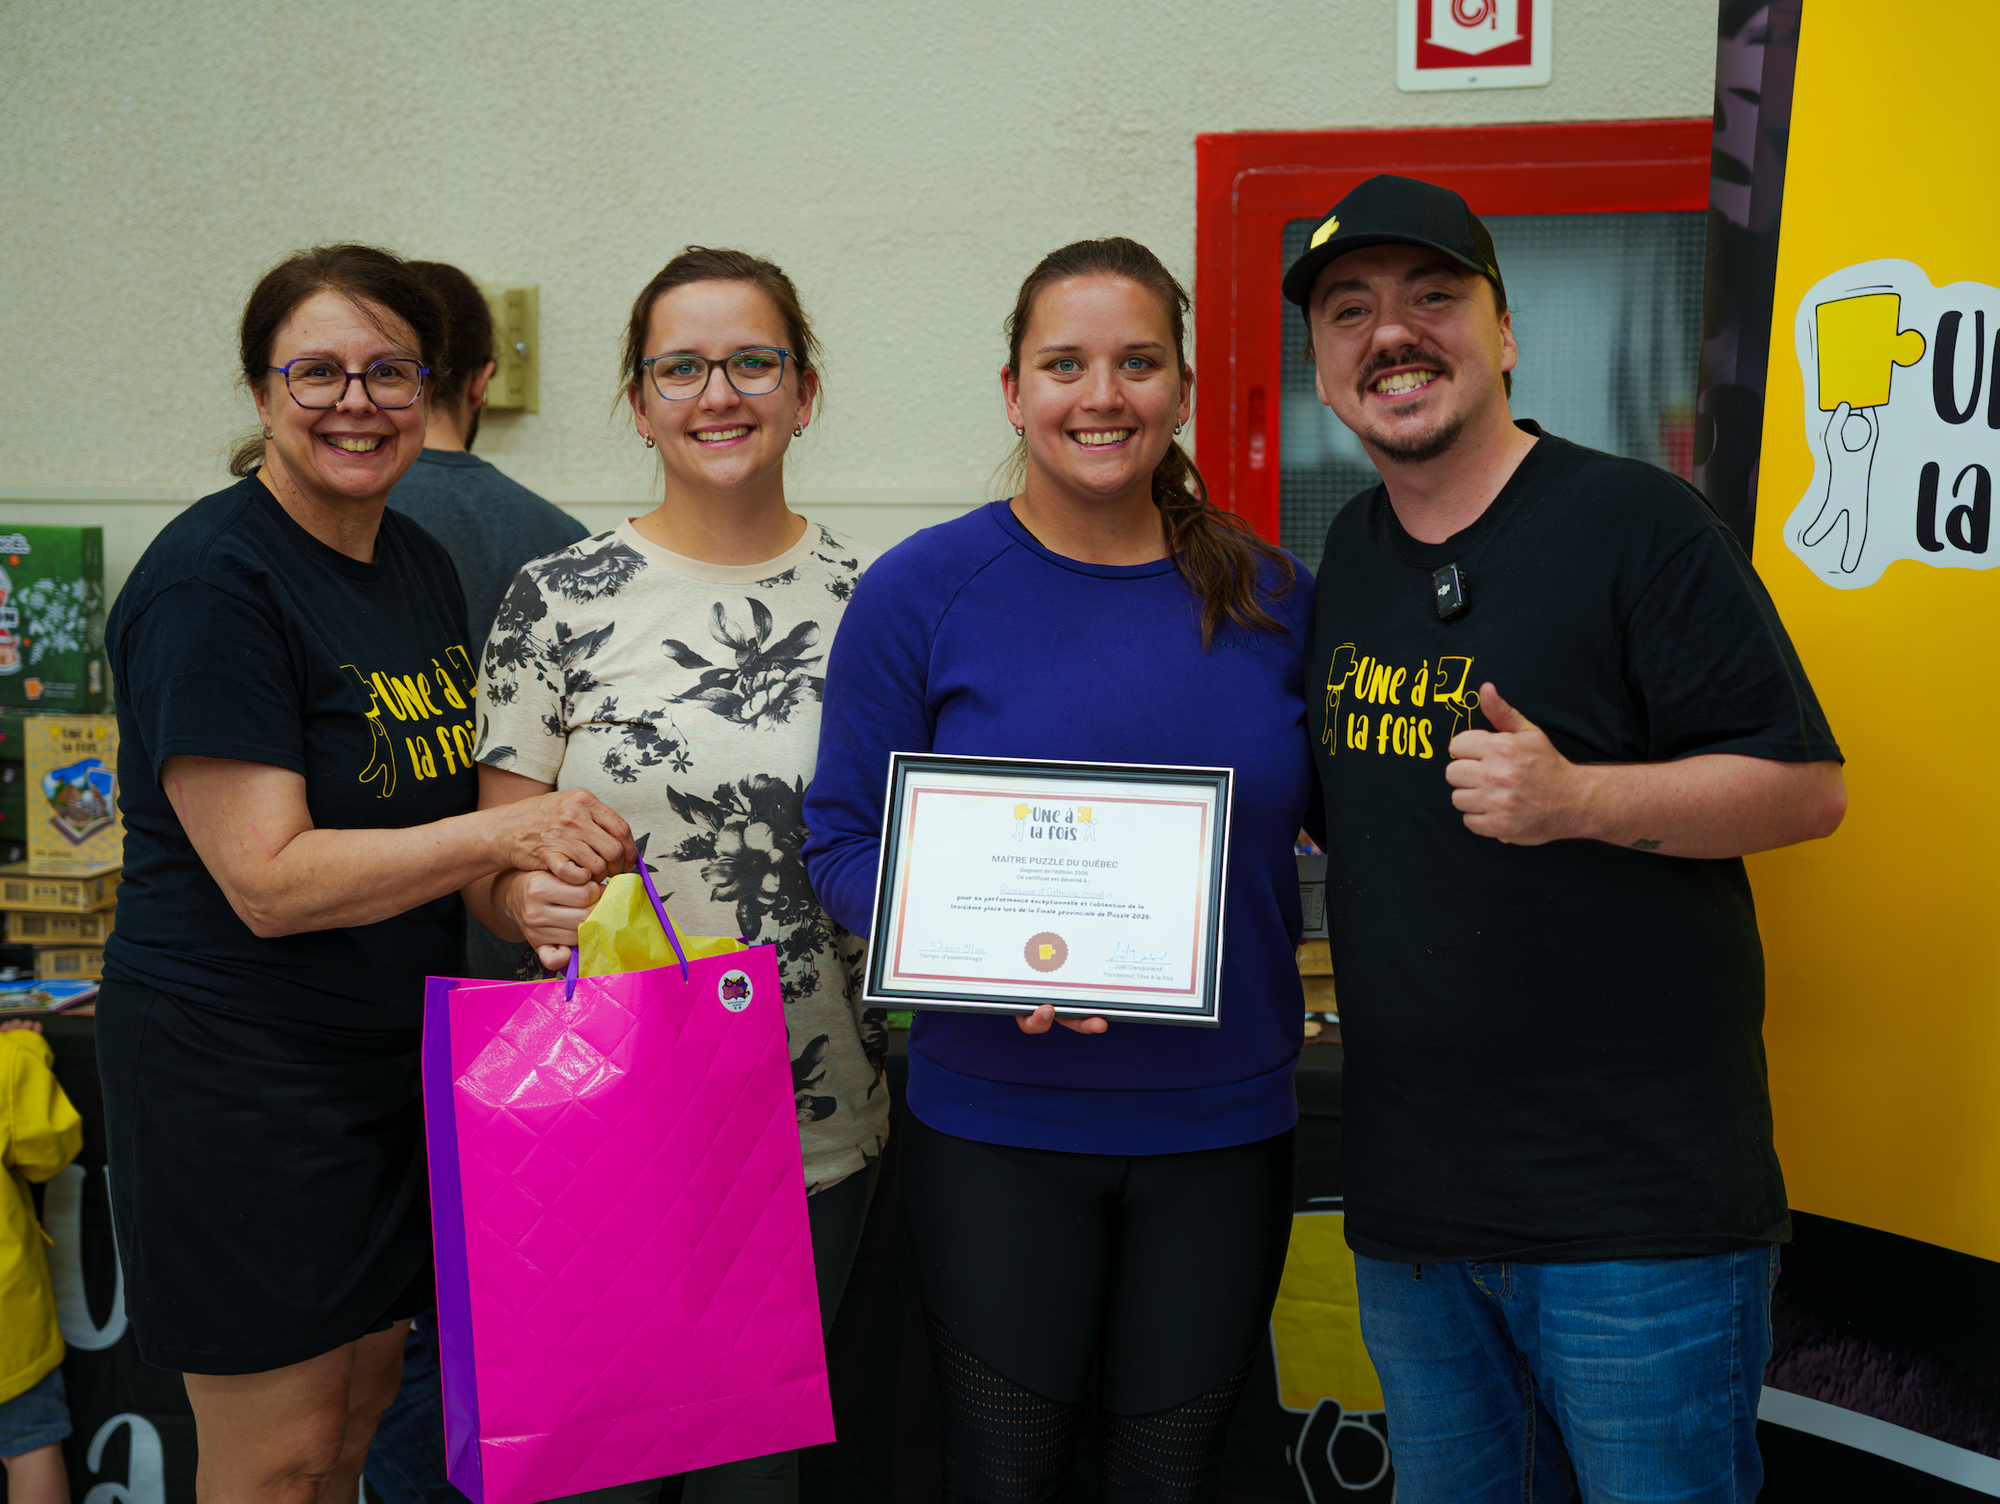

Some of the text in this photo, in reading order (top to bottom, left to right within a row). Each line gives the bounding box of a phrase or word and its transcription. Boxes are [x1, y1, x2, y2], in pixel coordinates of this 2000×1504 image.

[1933, 310, 2000, 429] U
[1916, 461, 1993, 554] la
[431, 658, 468, 710] à
[1410, 659, 1429, 708] à
[1346, 712, 1369, 751] la
[405, 735, 438, 781] la
[1065, 807, 1074, 824] à
[1030, 826, 1043, 839] la
[991, 854, 1119, 869] MAÎTRE PUZZLE DU QUÉBEC
[1019, 867, 1043, 875] Gagnant
[983, 896, 1029, 904] performance
[983, 905, 1001, 913] place
[1057, 909, 1096, 917] provinciale
[1107, 911, 1130, 919] Puzzle
[930, 941, 944, 952] 52
[941, 954, 983, 963] d'assemblage
[1103, 971, 1136, 979] Fondateur,
[1128, 964, 1163, 972] Dandurand
